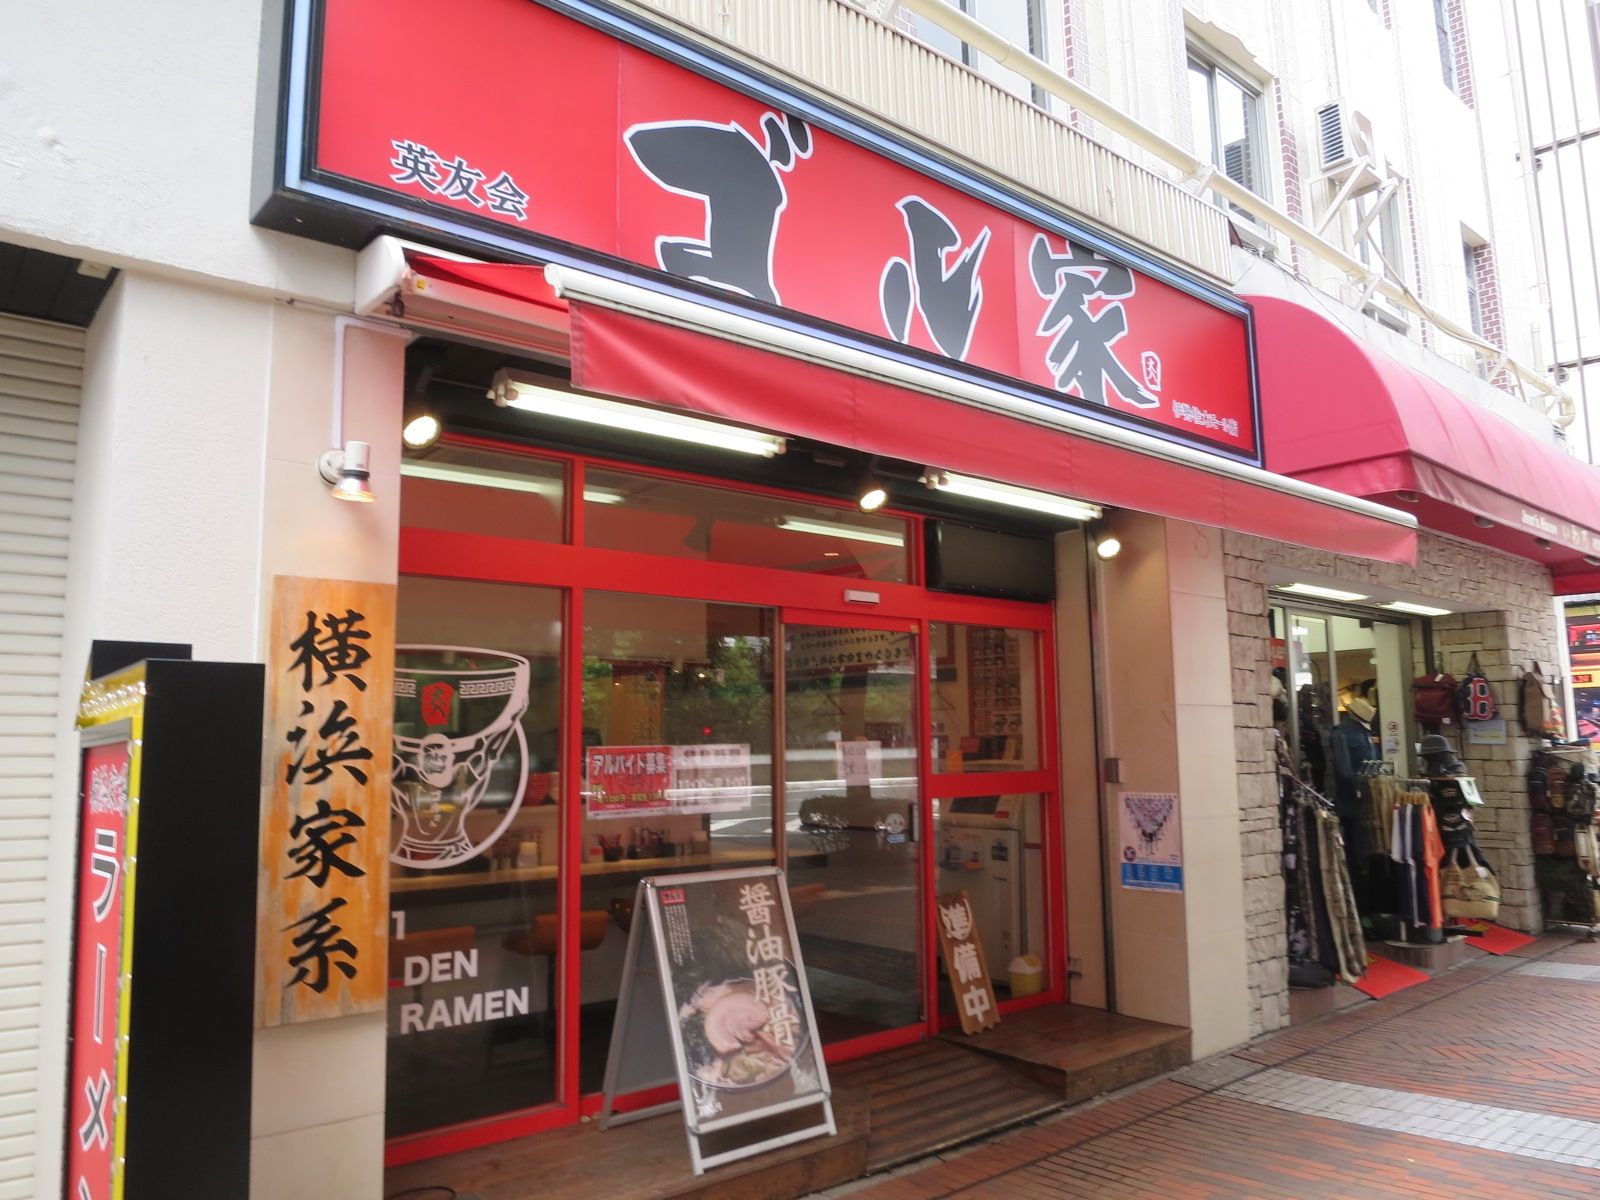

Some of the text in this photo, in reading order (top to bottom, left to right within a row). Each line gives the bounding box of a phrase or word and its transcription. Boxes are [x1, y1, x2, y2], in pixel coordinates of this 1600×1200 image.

[390, 139, 530, 221] 英友会
[283, 608, 374, 994] 横浜家系
[592, 751, 667, 776] アルバイト募集
[404, 949, 478, 986] DEN
[738, 882, 800, 1047] 醤油豚骨
[937, 898, 991, 1023] 準備中
[401, 976, 529, 1034] RAMEN
